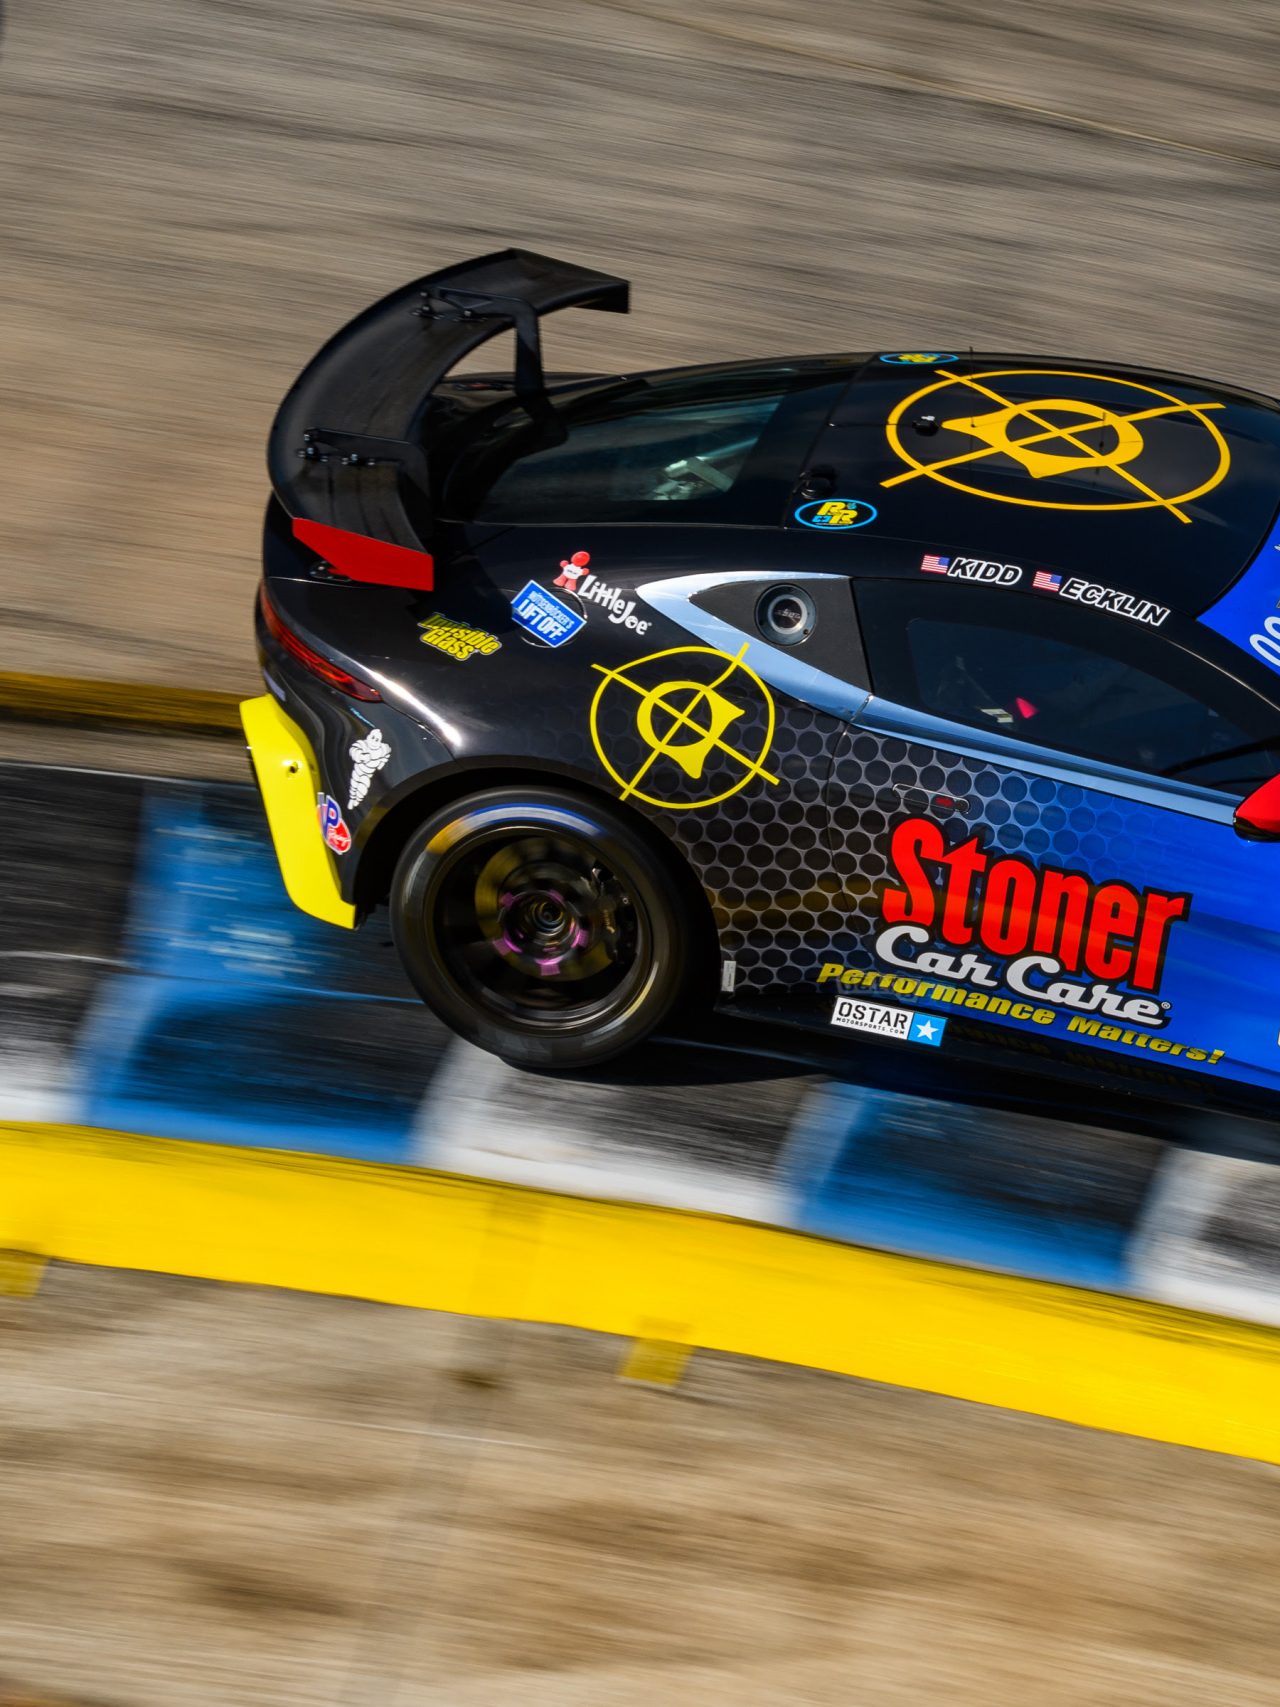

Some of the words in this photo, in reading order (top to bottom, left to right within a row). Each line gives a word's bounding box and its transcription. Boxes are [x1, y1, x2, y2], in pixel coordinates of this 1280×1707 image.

[948, 557, 1022, 585] KIDD
[1060, 577, 1171, 626] ECKLIN
[422, 629, 475, 659] Glass
[537, 615, 568, 639] OFF
[882, 818, 1185, 990] Stoner
[876, 925, 998, 987] Car
[817, 963, 1057, 1026] Performance
[1067, 1015, 1225, 1064] Matters!
[836, 1017, 905, 1035] MOTORSPORTS.COM
